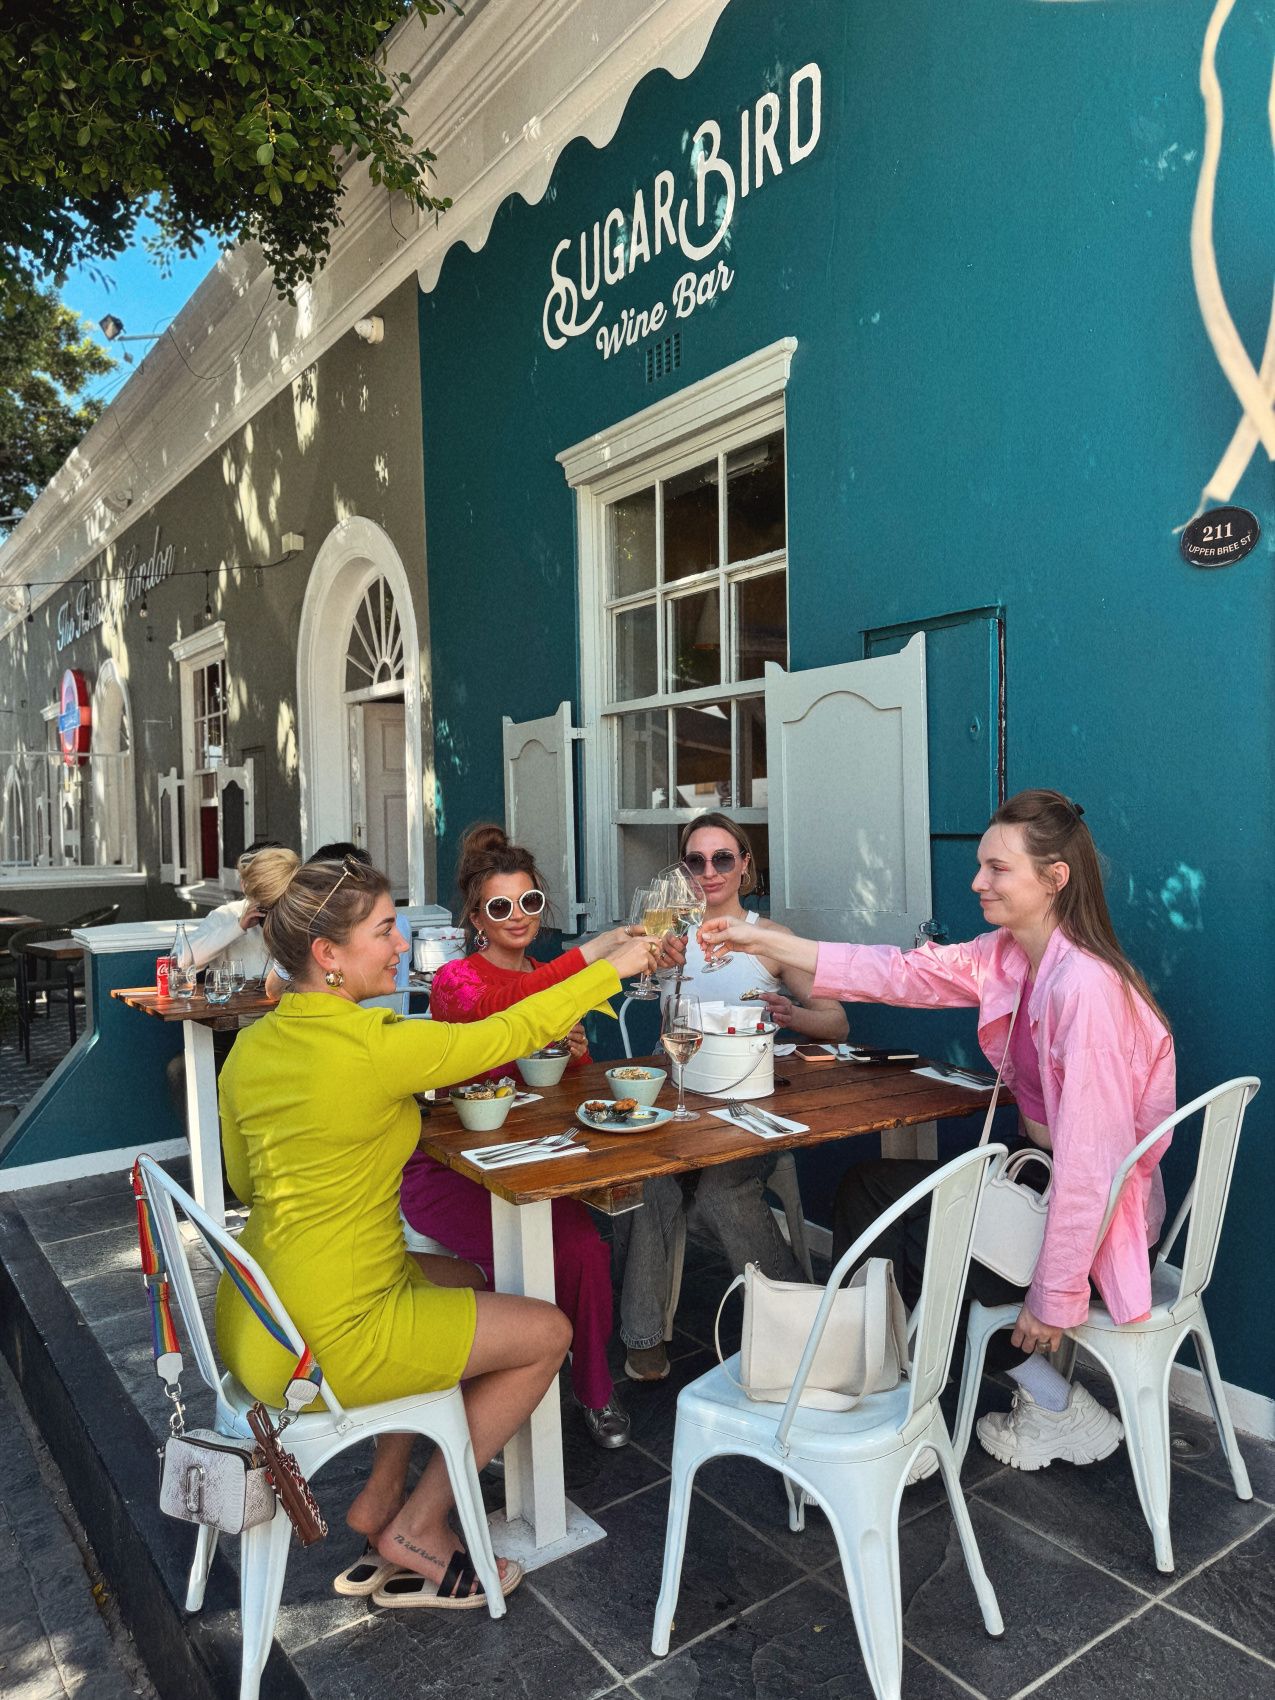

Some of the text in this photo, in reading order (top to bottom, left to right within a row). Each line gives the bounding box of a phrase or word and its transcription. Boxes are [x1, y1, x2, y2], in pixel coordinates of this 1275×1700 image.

[596, 259, 735, 360] Wine Bar
[1188, 534, 1252, 556] UPPER BREE ST
[1202, 522, 1233, 542] 211
[125, 525, 176, 602] London
